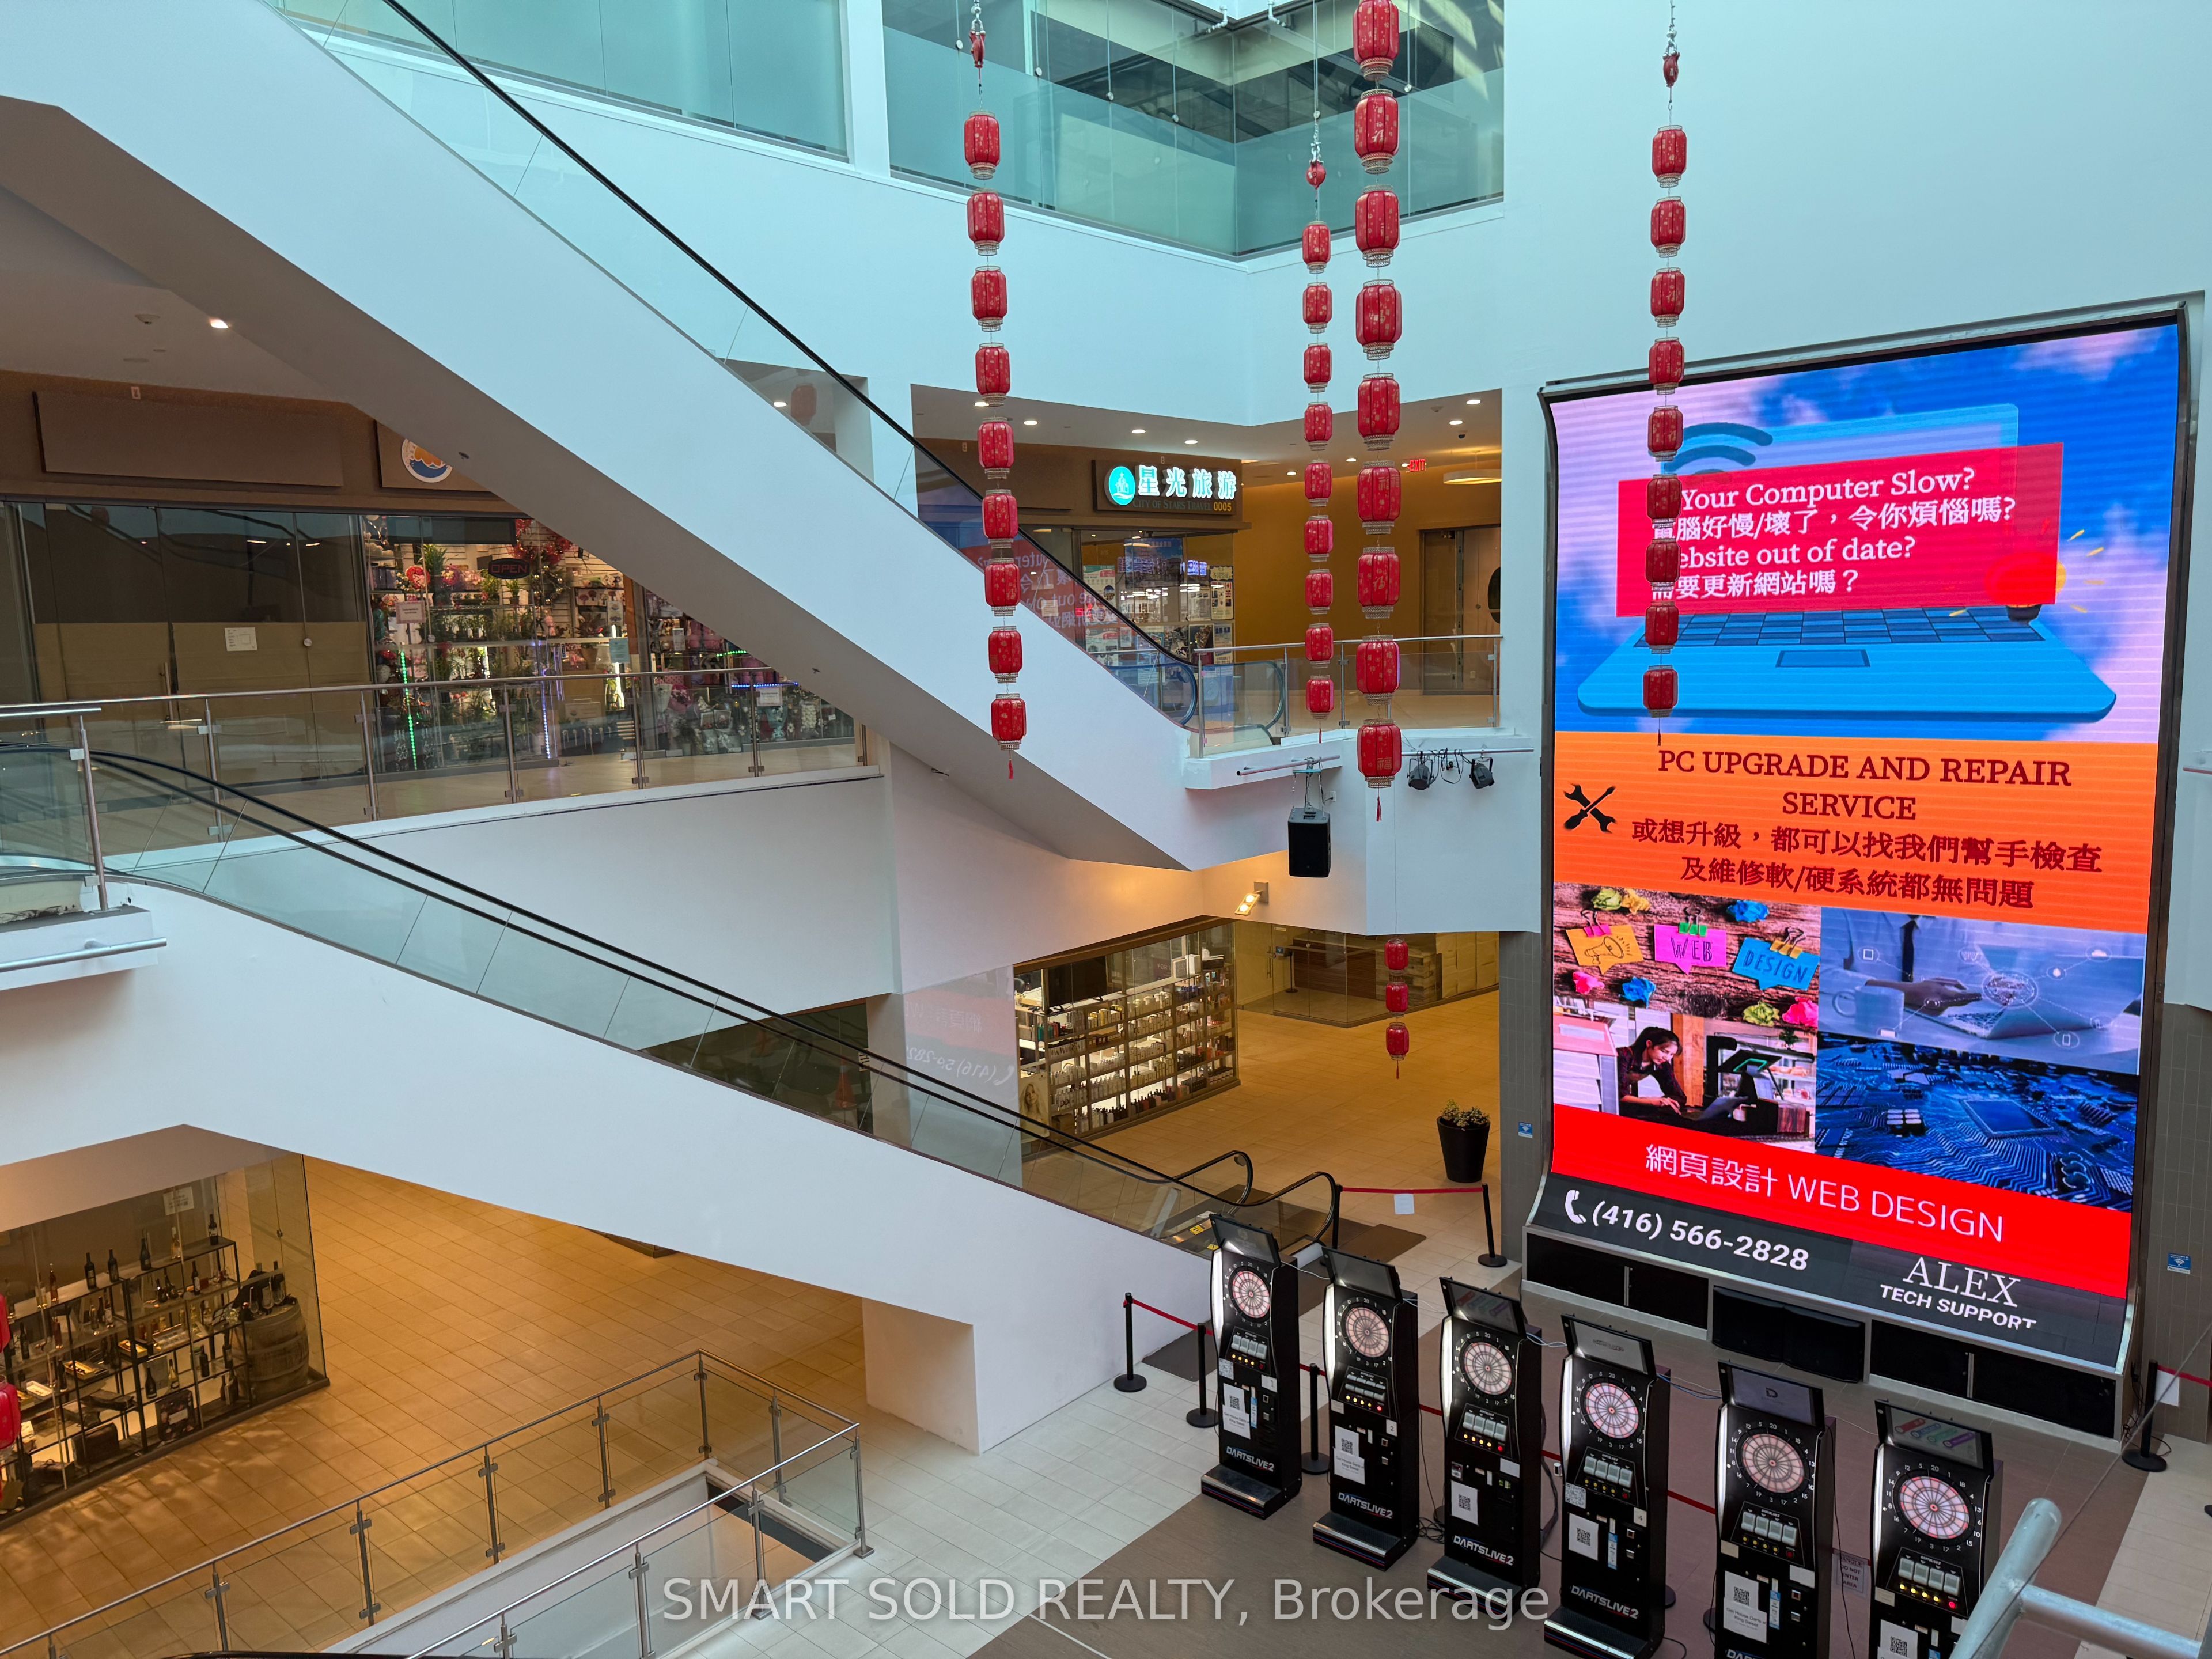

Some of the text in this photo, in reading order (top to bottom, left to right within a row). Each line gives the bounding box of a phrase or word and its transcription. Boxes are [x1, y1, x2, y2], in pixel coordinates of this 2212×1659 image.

[1138, 464, 1237, 500] 星光旅游
[1410, 459, 1425, 472] EXIT
[1681, 467, 1976, 510] Your Computer Slow?
[1213, 501, 1232, 512] 0005
[491, 564, 527, 574] OPEN
[1680, 535, 1916, 569] ebsite out of date?
[1658, 749, 2072, 786] PC UPGRADE AND REPAIR
[1782, 791, 1916, 820] SERVICE
[1631, 817, 2103, 872] 或想升級，都可以找我們幫手檢查
[1681, 856, 2034, 908] 及維修軟/硬系統都無問題
[1671, 936, 1713, 962] WEB
[1743, 949, 1809, 984] DESIGN
[1646, 1143, 2003, 1243] 網頁設計 WEB DESIGN
[1593, 1201, 1809, 1271] (416) 566-2828
[1902, 1257, 2021, 1308] ALEX
[1880, 1284, 2037, 1330] TECH SUPPORT
[1226, 1445, 1275, 1473] DARTSLIVE2
[1338, 1492, 1393, 1519] DARTSLIVE2
[1453, 1535, 1514, 1566] DARTSLIVE2
[1571, 1585, 1639, 1619] DARTSLIVE2
